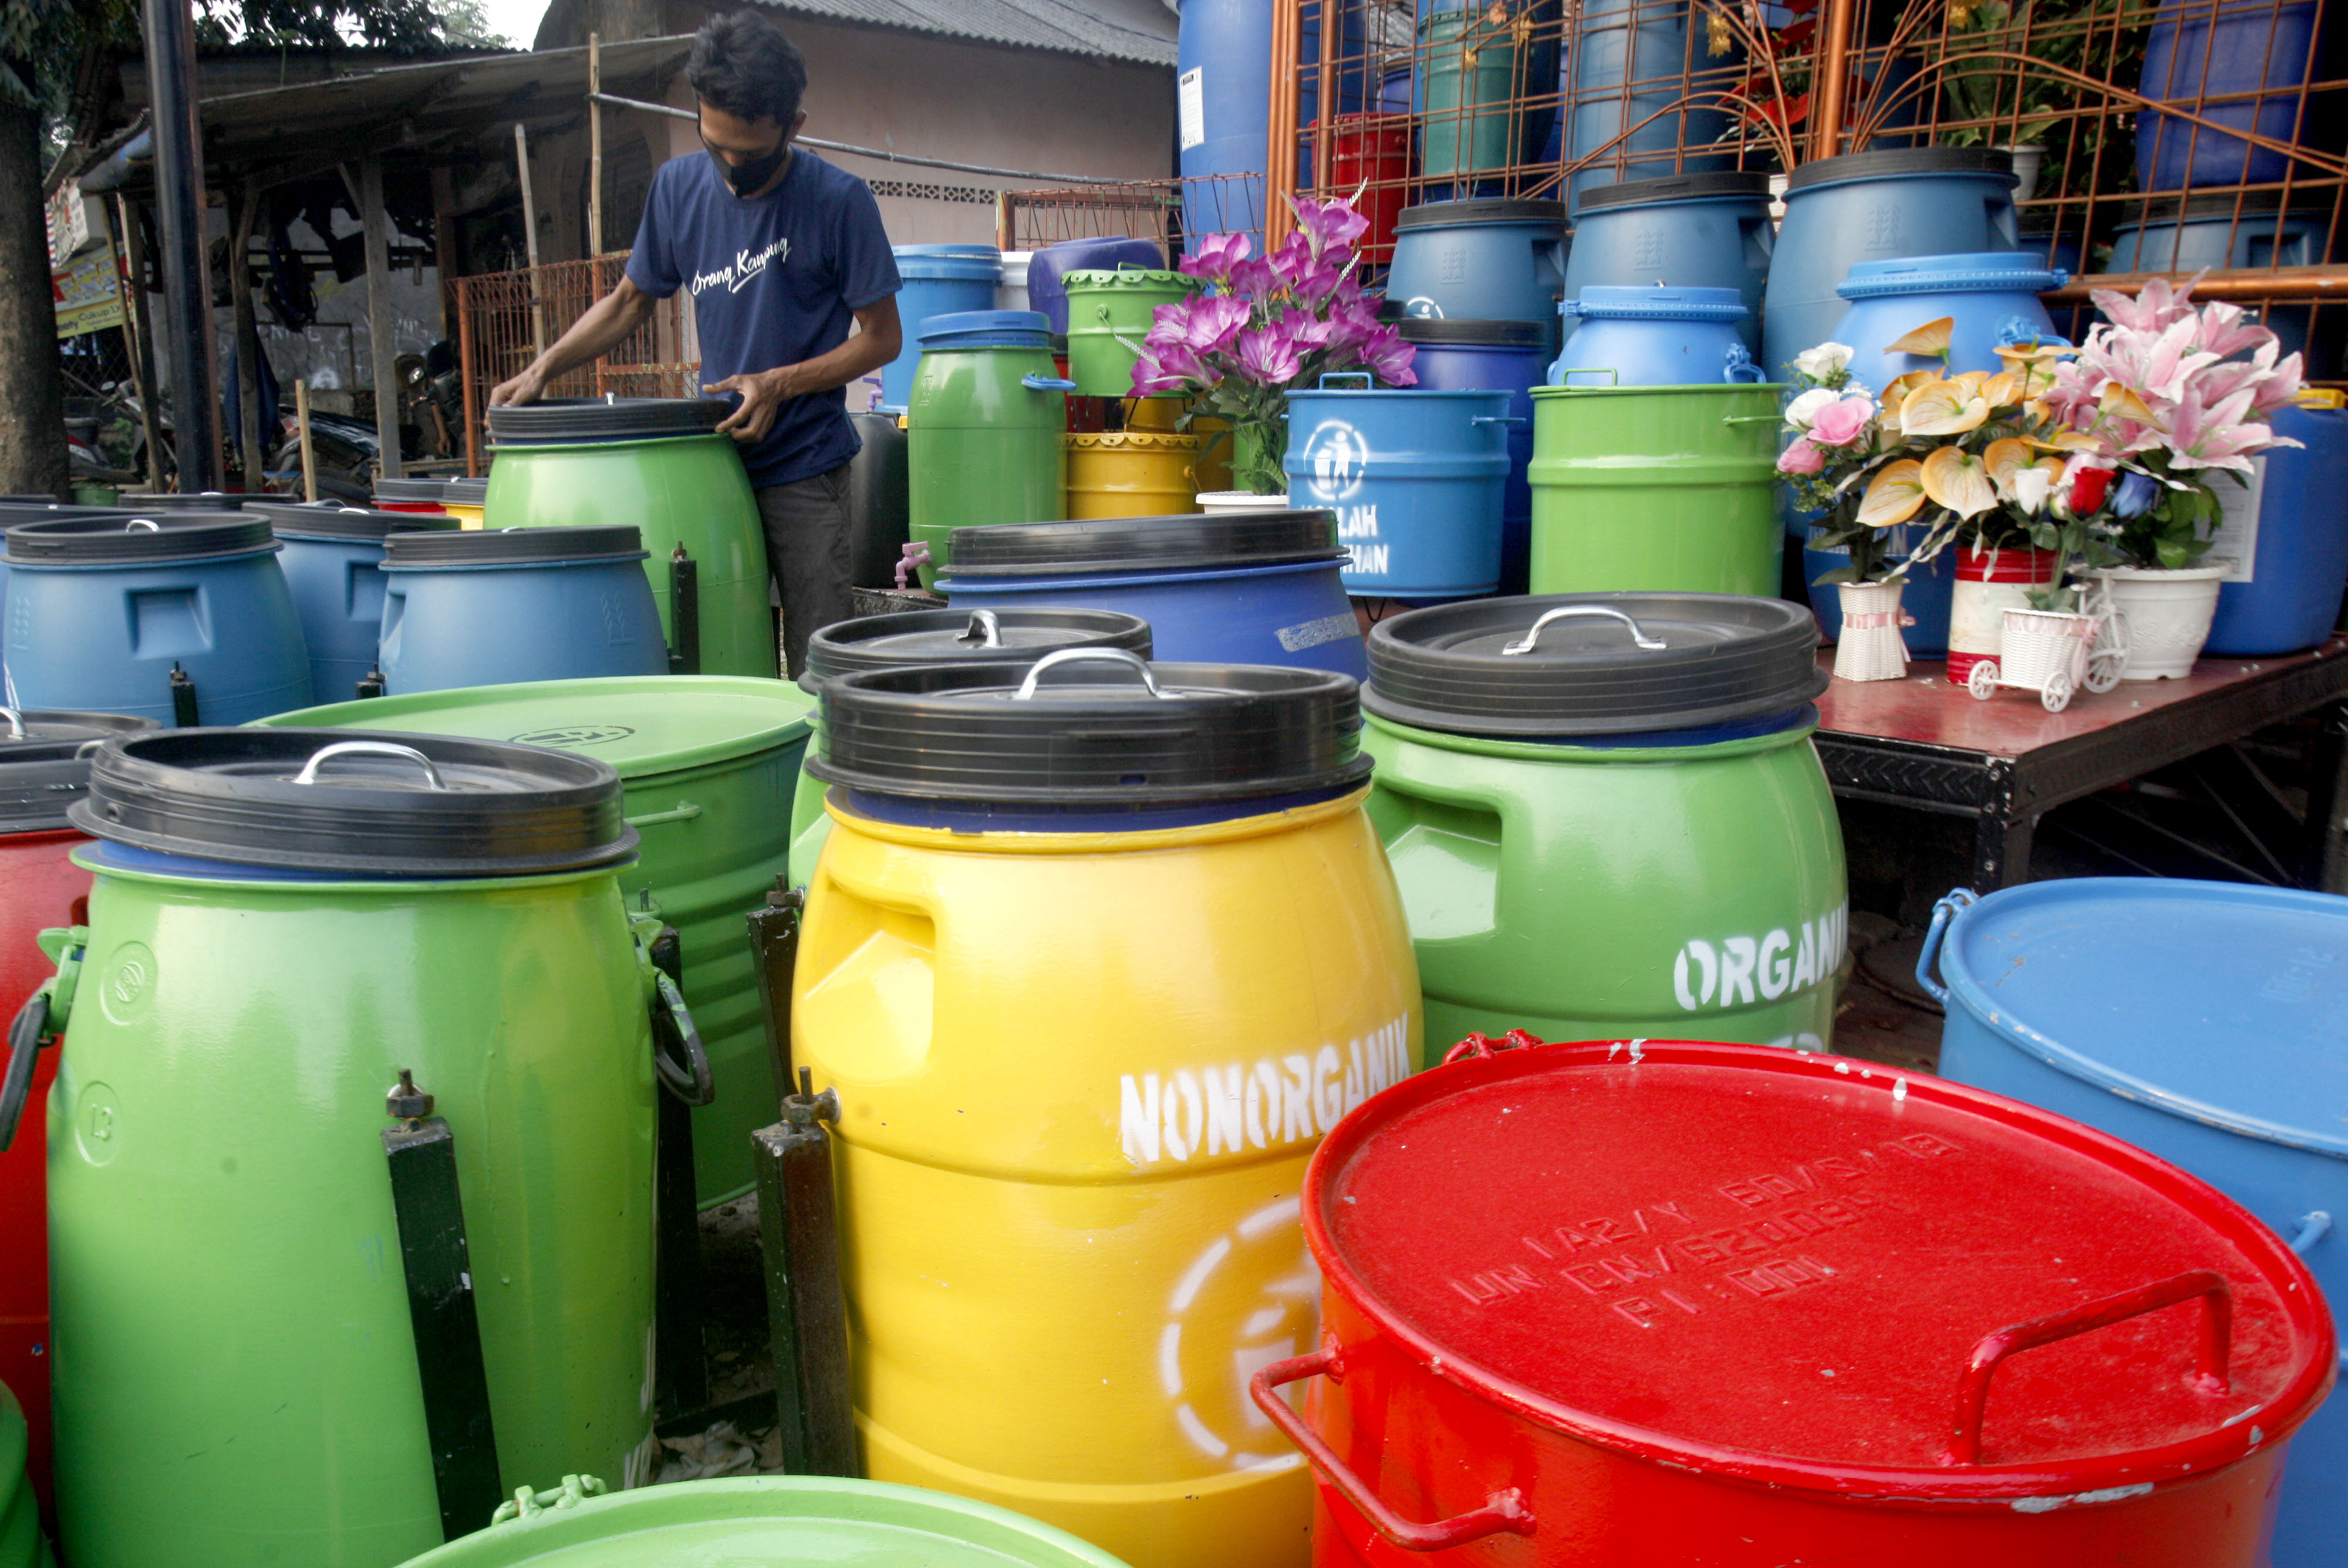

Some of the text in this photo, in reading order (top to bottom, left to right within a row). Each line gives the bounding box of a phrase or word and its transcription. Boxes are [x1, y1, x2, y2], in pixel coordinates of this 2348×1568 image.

[692, 266, 736, 296] Orang
[1674, 894, 1849, 1011] ORGANI
[1120, 1011, 1411, 1162] NONORGANIK
